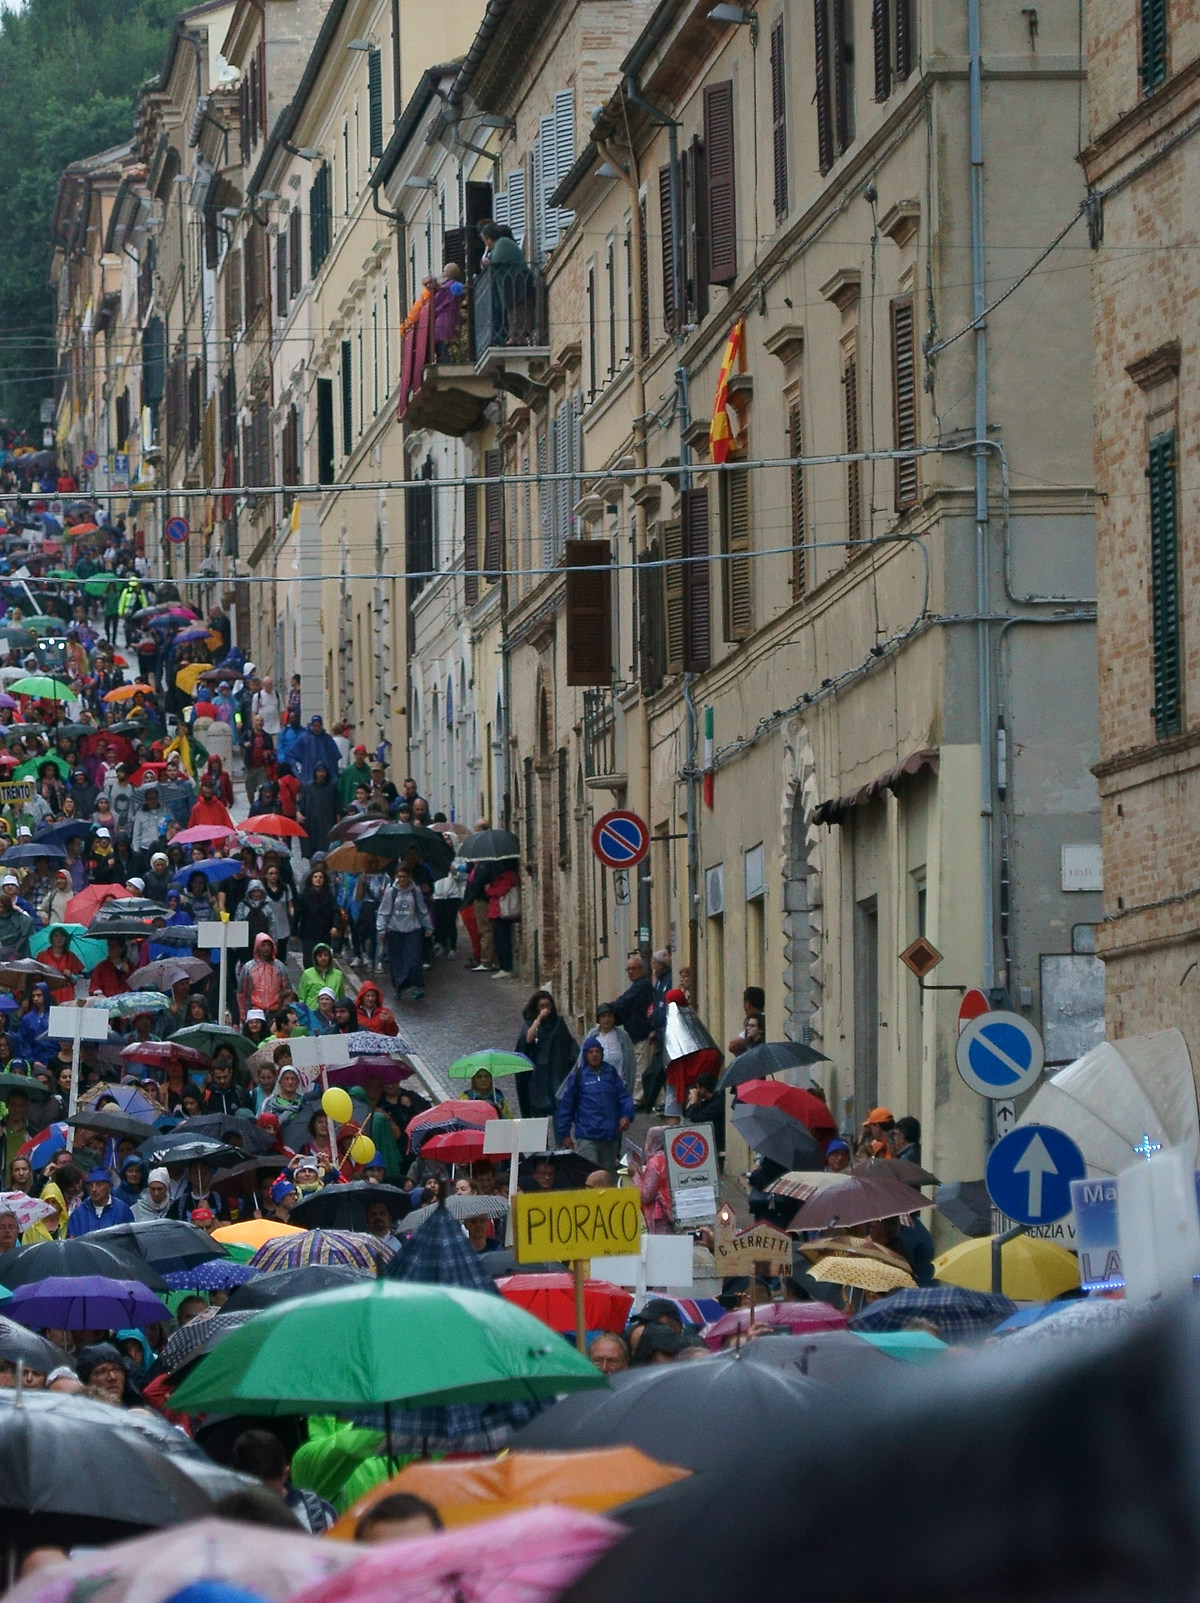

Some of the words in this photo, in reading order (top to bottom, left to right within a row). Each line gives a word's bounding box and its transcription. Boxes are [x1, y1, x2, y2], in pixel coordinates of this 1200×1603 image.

[2, 784, 30, 800] TRENTO
[527, 1201, 638, 1245] PIORACO
[733, 1235, 790, 1253] FERRETTI
[778, 1264, 792, 1276] AN
